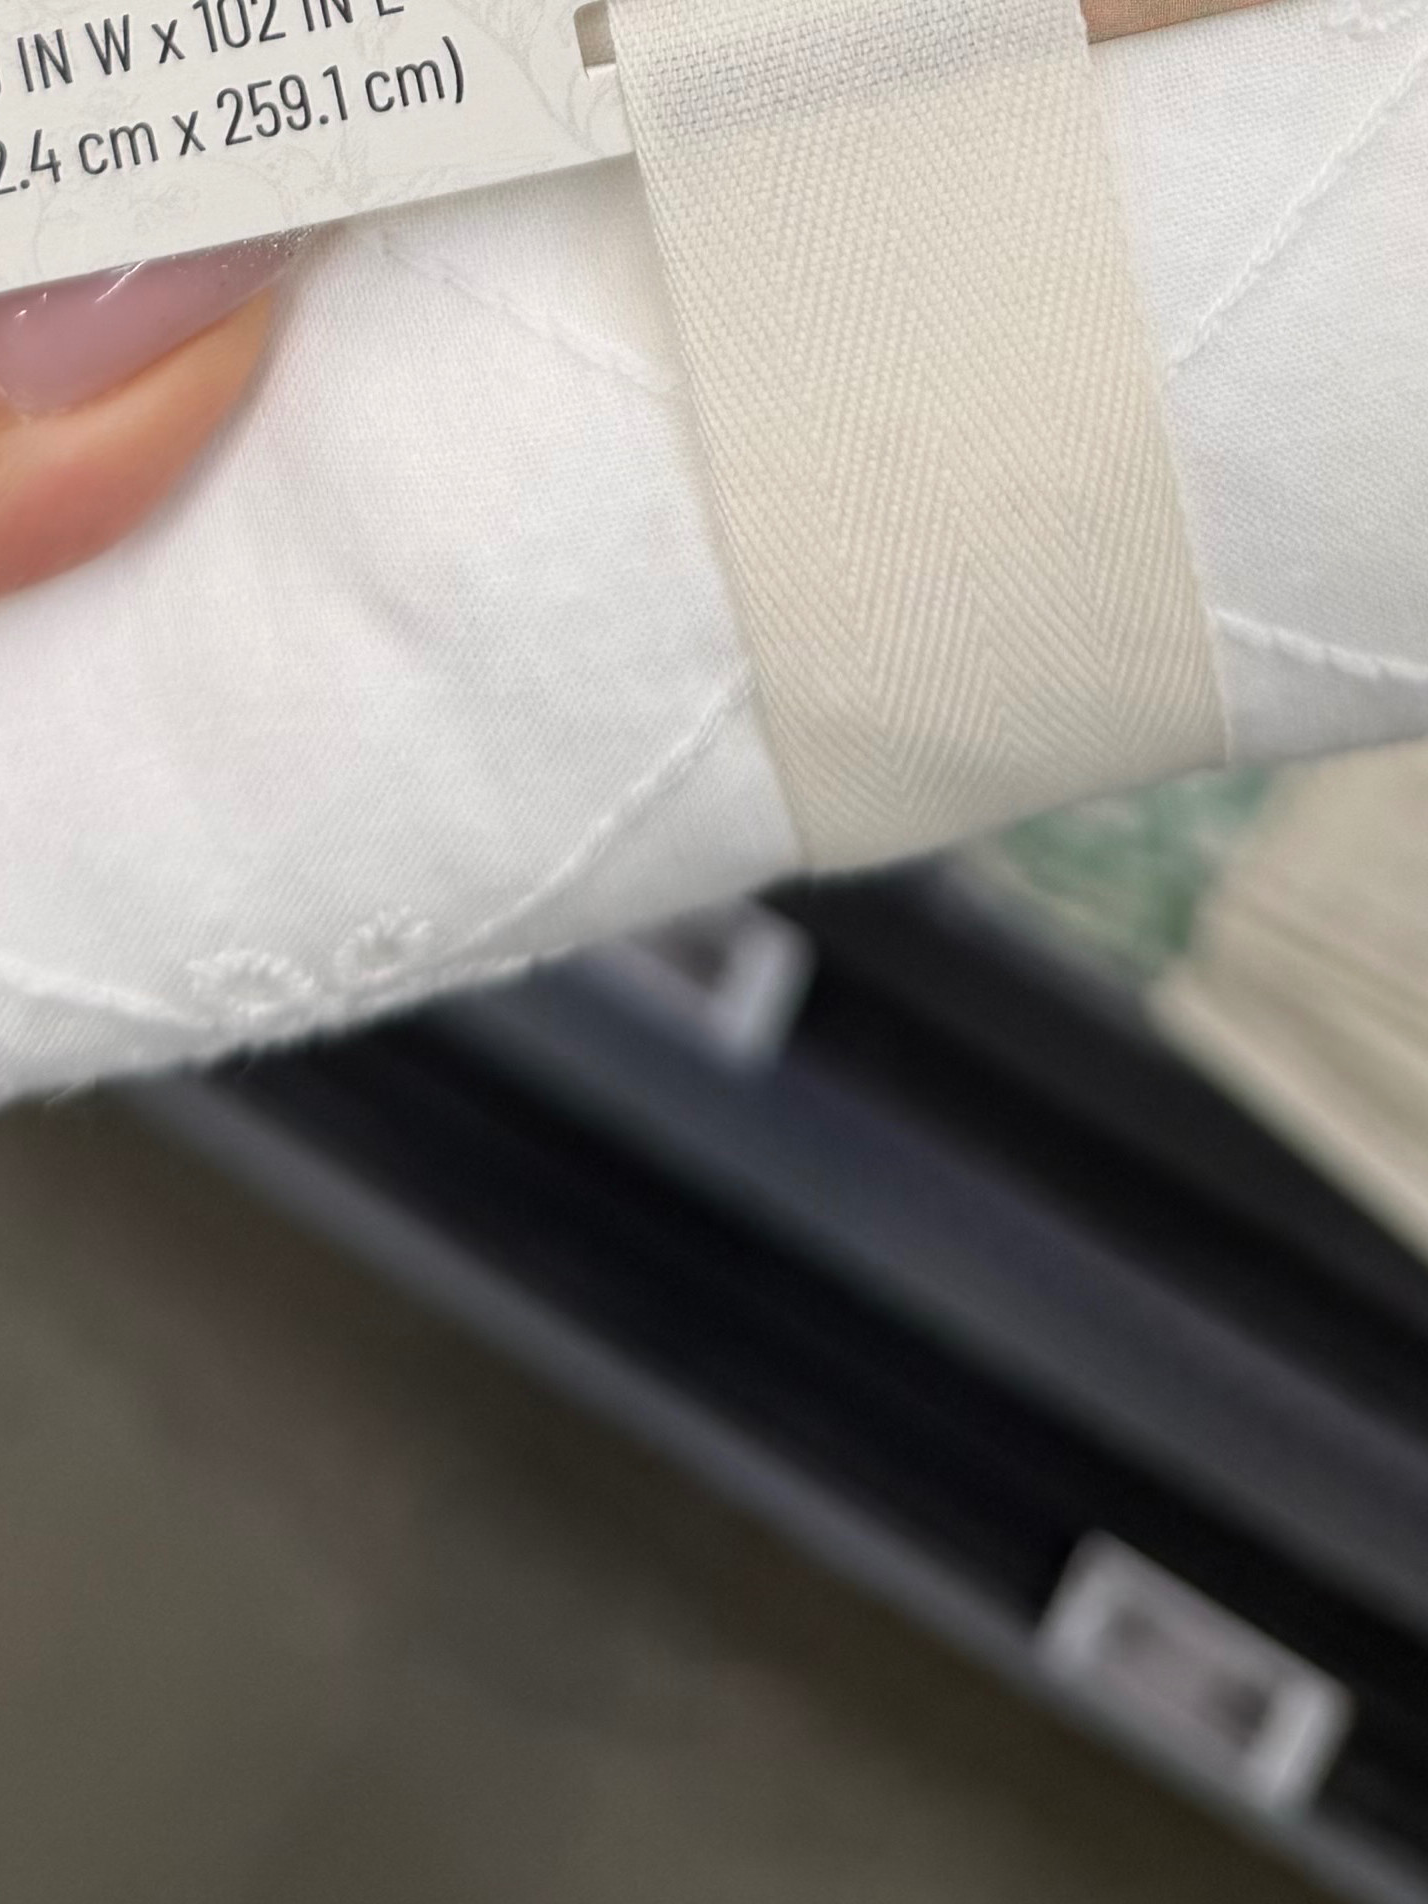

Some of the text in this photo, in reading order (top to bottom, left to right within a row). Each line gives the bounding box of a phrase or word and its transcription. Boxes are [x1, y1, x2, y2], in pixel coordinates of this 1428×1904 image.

[16, 28, 74, 93] IN
[84, 13, 131, 77] W
[150, 18, 186, 66] x
[77, 121, 160, 176] cm
[171, 109, 207, 158] x
[216, 64, 349, 147] 259.1
[364, 35, 465, 114] cm)
